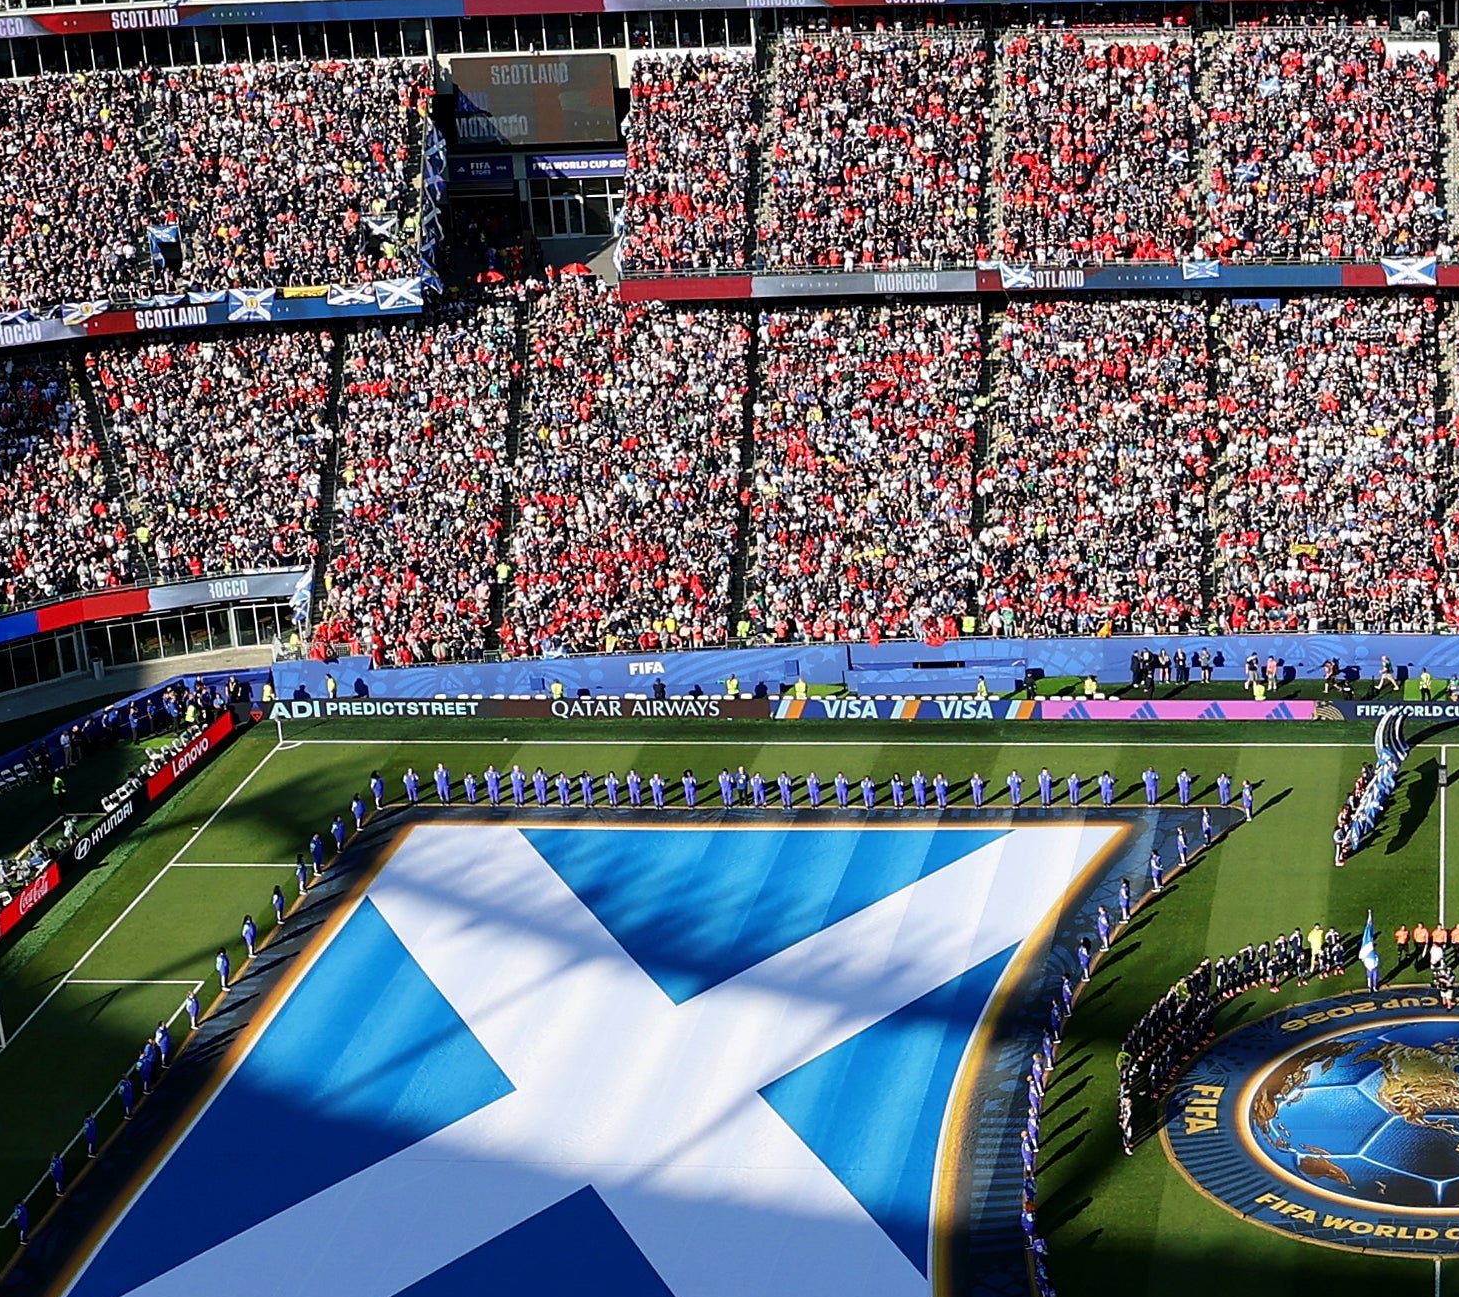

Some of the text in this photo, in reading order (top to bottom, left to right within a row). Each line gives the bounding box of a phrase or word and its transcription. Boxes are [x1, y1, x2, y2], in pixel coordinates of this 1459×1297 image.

[111, 8, 179, 30] SCOTLAND
[491, 62, 569, 86] SCOTLAND
[470, 161, 491, 171] FIFA
[553, 161, 589, 171] WORLD
[589, 160, 608, 169] CUP
[873, 273, 938, 292] MOROCCO
[135, 306, 208, 331] SCOTLAND
[629, 661, 665, 676] FIFA
[269, 700, 479, 720] ADI PREDICTSTREET
[551, 699, 720, 720] QATAR AIRWAYS
[820, 699, 879, 719] VISA
[934, 699, 993, 719] VISA
[1356, 705, 1386, 717] FIFA
[171, 736, 210, 779] Lenovo
[90, 800, 134, 847] HYUNDAI
[1280, 1000, 1379, 1031] 2026
[1184, 1084, 1225, 1137] FIFA
[1254, 1192, 1320, 1225] FIFA
[1322, 1213, 1439, 1241] WORLD
